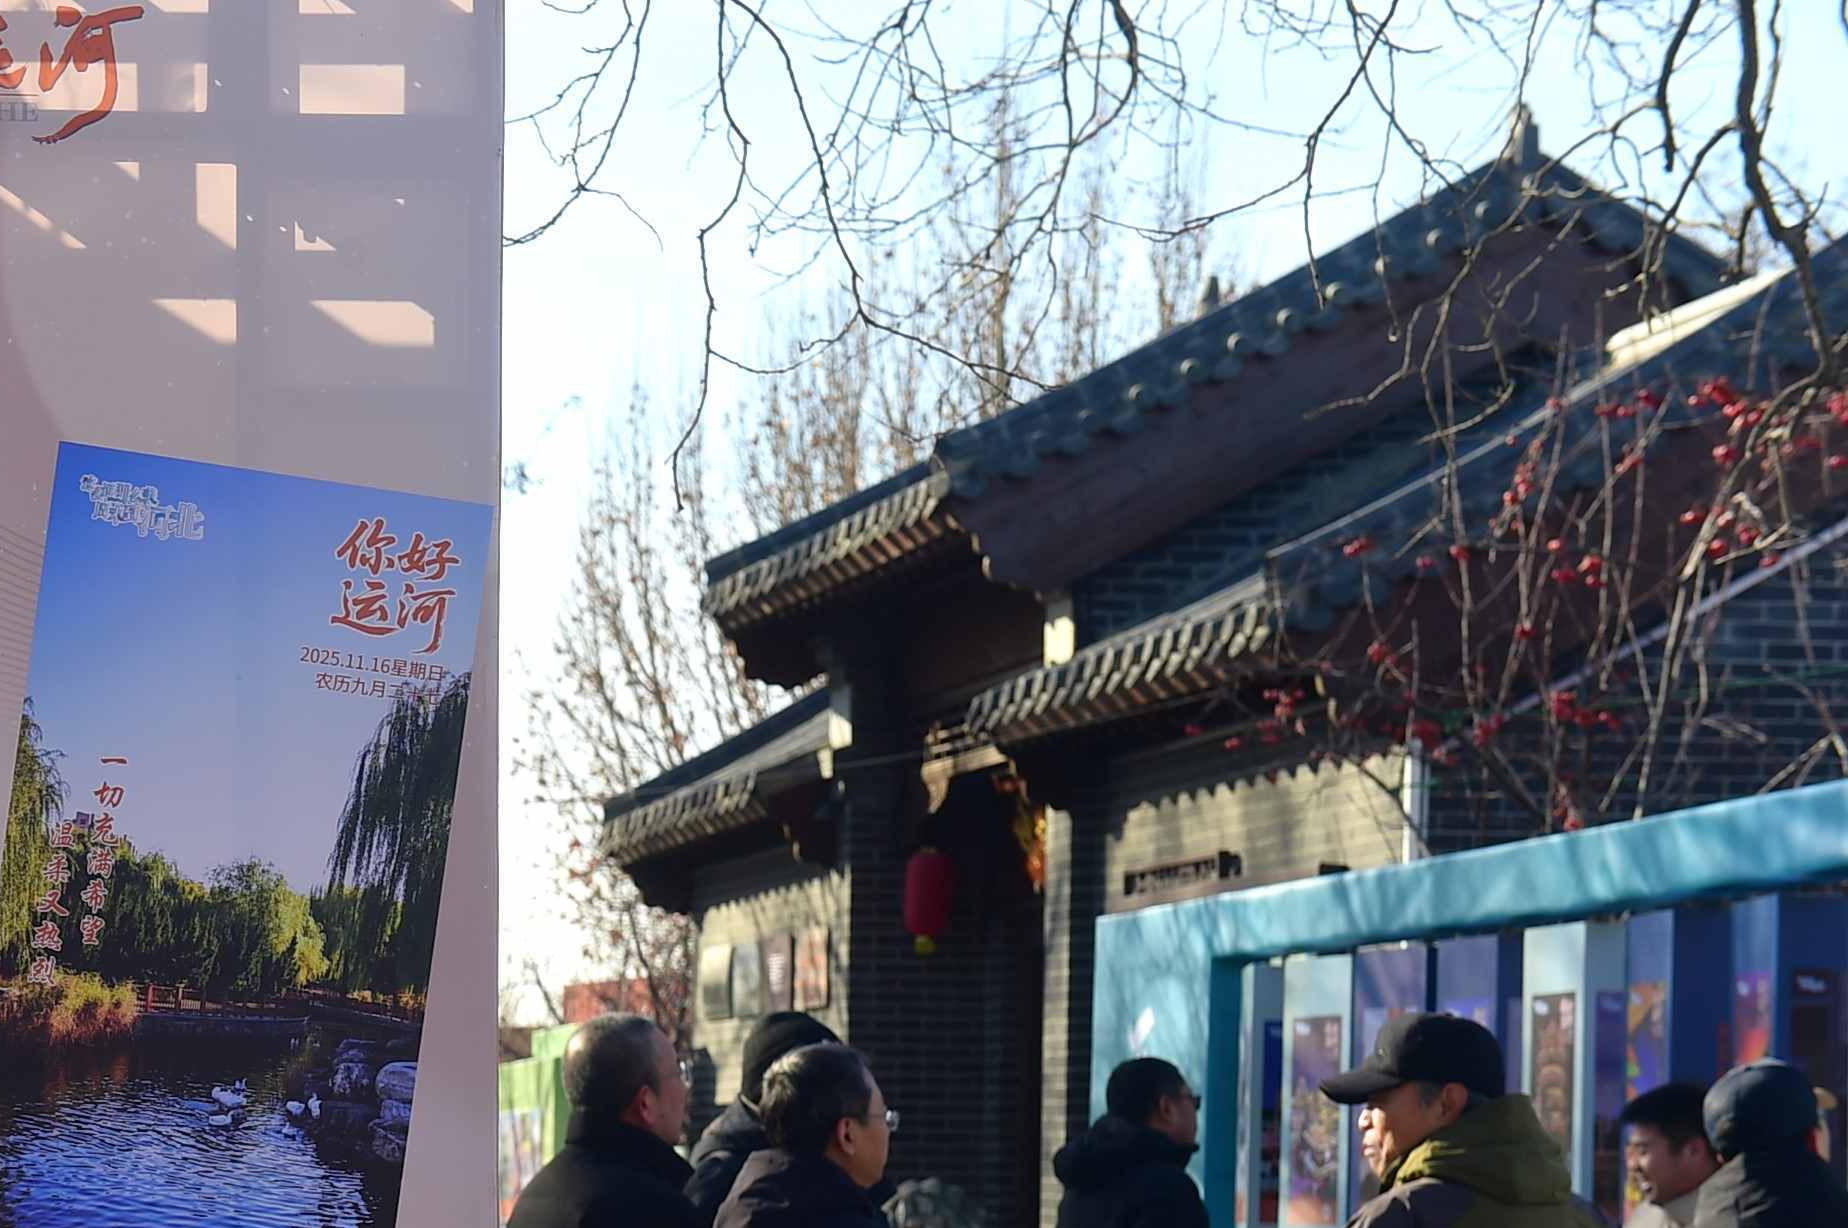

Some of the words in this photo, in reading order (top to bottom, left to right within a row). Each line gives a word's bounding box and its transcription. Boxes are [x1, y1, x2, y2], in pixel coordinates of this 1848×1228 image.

[335, 516, 462, 582] 你好
[329, 580, 456, 656] 运河
[300, 646, 446, 682] 2025.11.16星期日
[80, 756, 128, 945] 一切充满希望
[27, 822, 76, 986] 温柔又热烈
